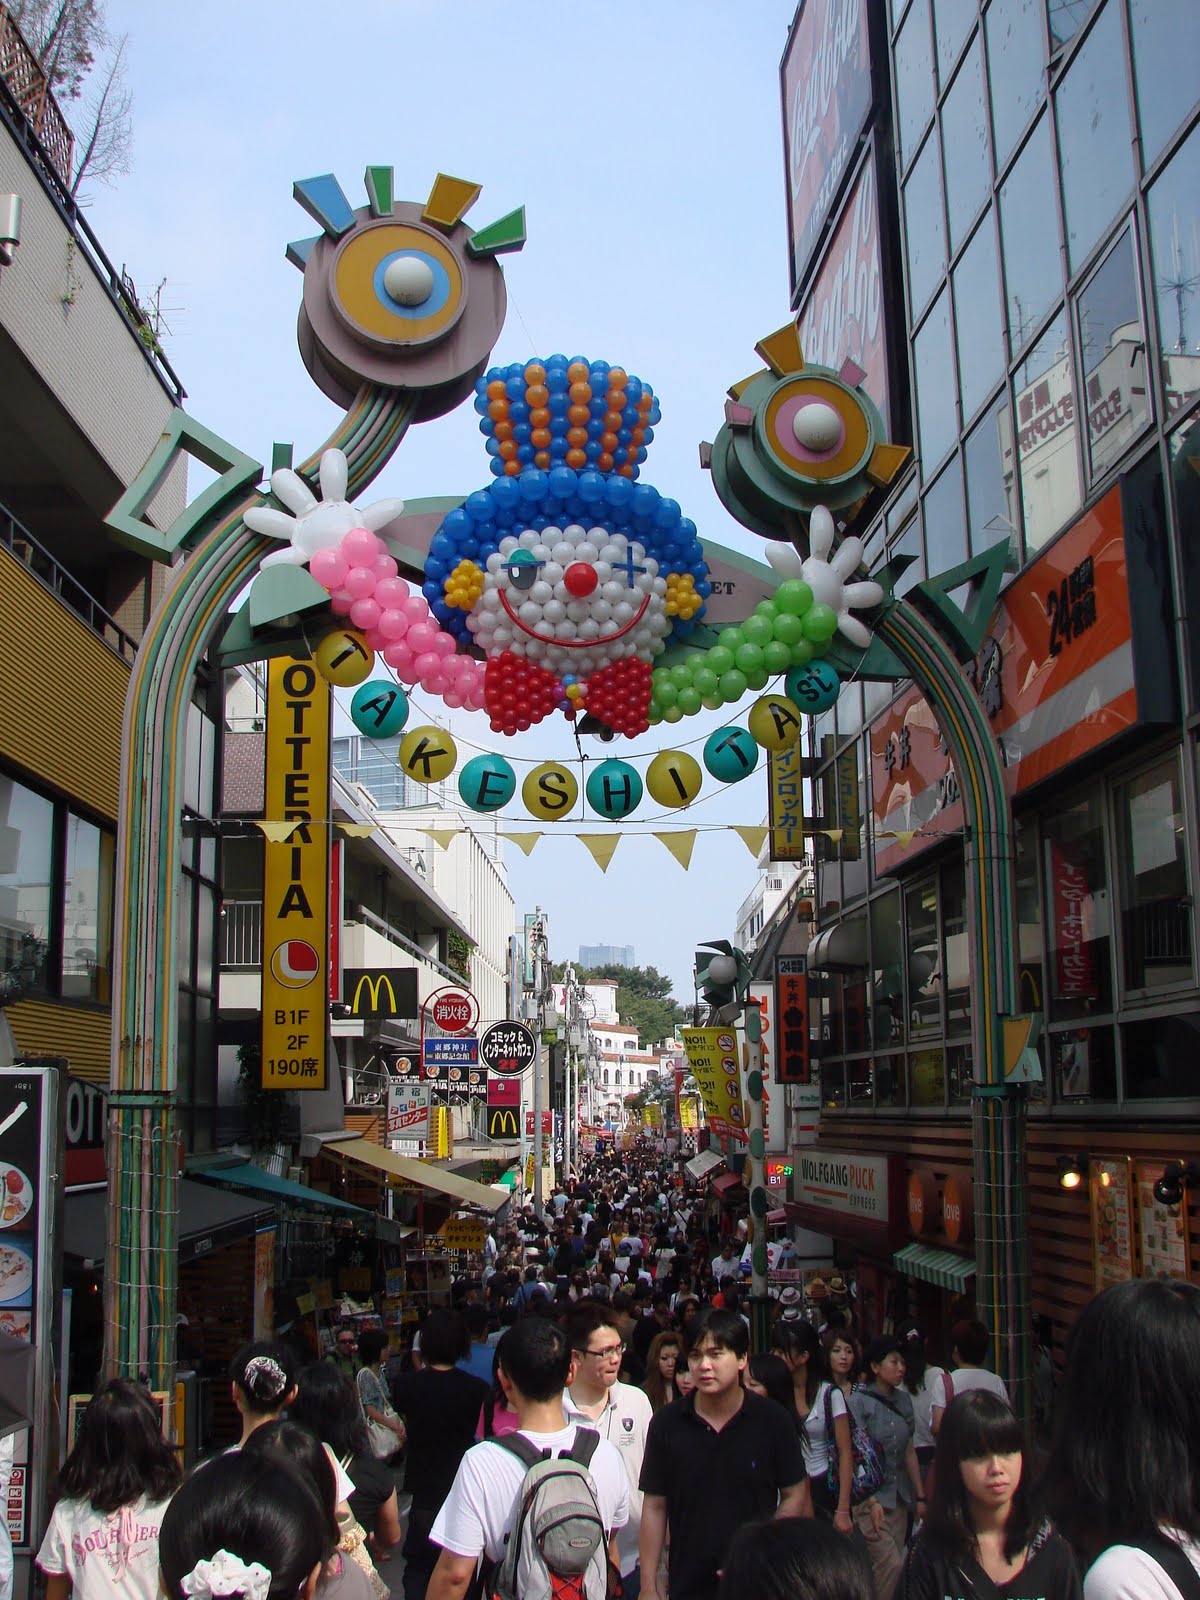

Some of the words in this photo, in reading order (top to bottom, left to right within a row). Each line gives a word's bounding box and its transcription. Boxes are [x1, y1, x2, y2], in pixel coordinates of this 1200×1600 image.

[330, 634, 799, 811] TAKESHITA
[776, 750, 800, 843] インロッカー
[436, 1005, 468, 1020] 消火栓
[287, 1035, 309, 1050] 2F
[491, 1031, 516, 1043] コミック
[517, 1031, 524, 1042] &
[684, 1036, 706, 1044] NO!!
[484, 1043, 532, 1058] インターネットカフェ
[268, 1057, 318, 1077] 190席
[498, 1060, 518, 1069] 2F
[395, 1087, 421, 1096] 原宿
[770, 1176, 781, 1184] B1
[801, 1157, 848, 1187] WOLFGANG
[850, 1164, 875, 1191] PUCK
[850, 1193, 876, 1212] EXPRESS
[909, 1191, 922, 1213] live
[943, 1201, 960, 1222] love
